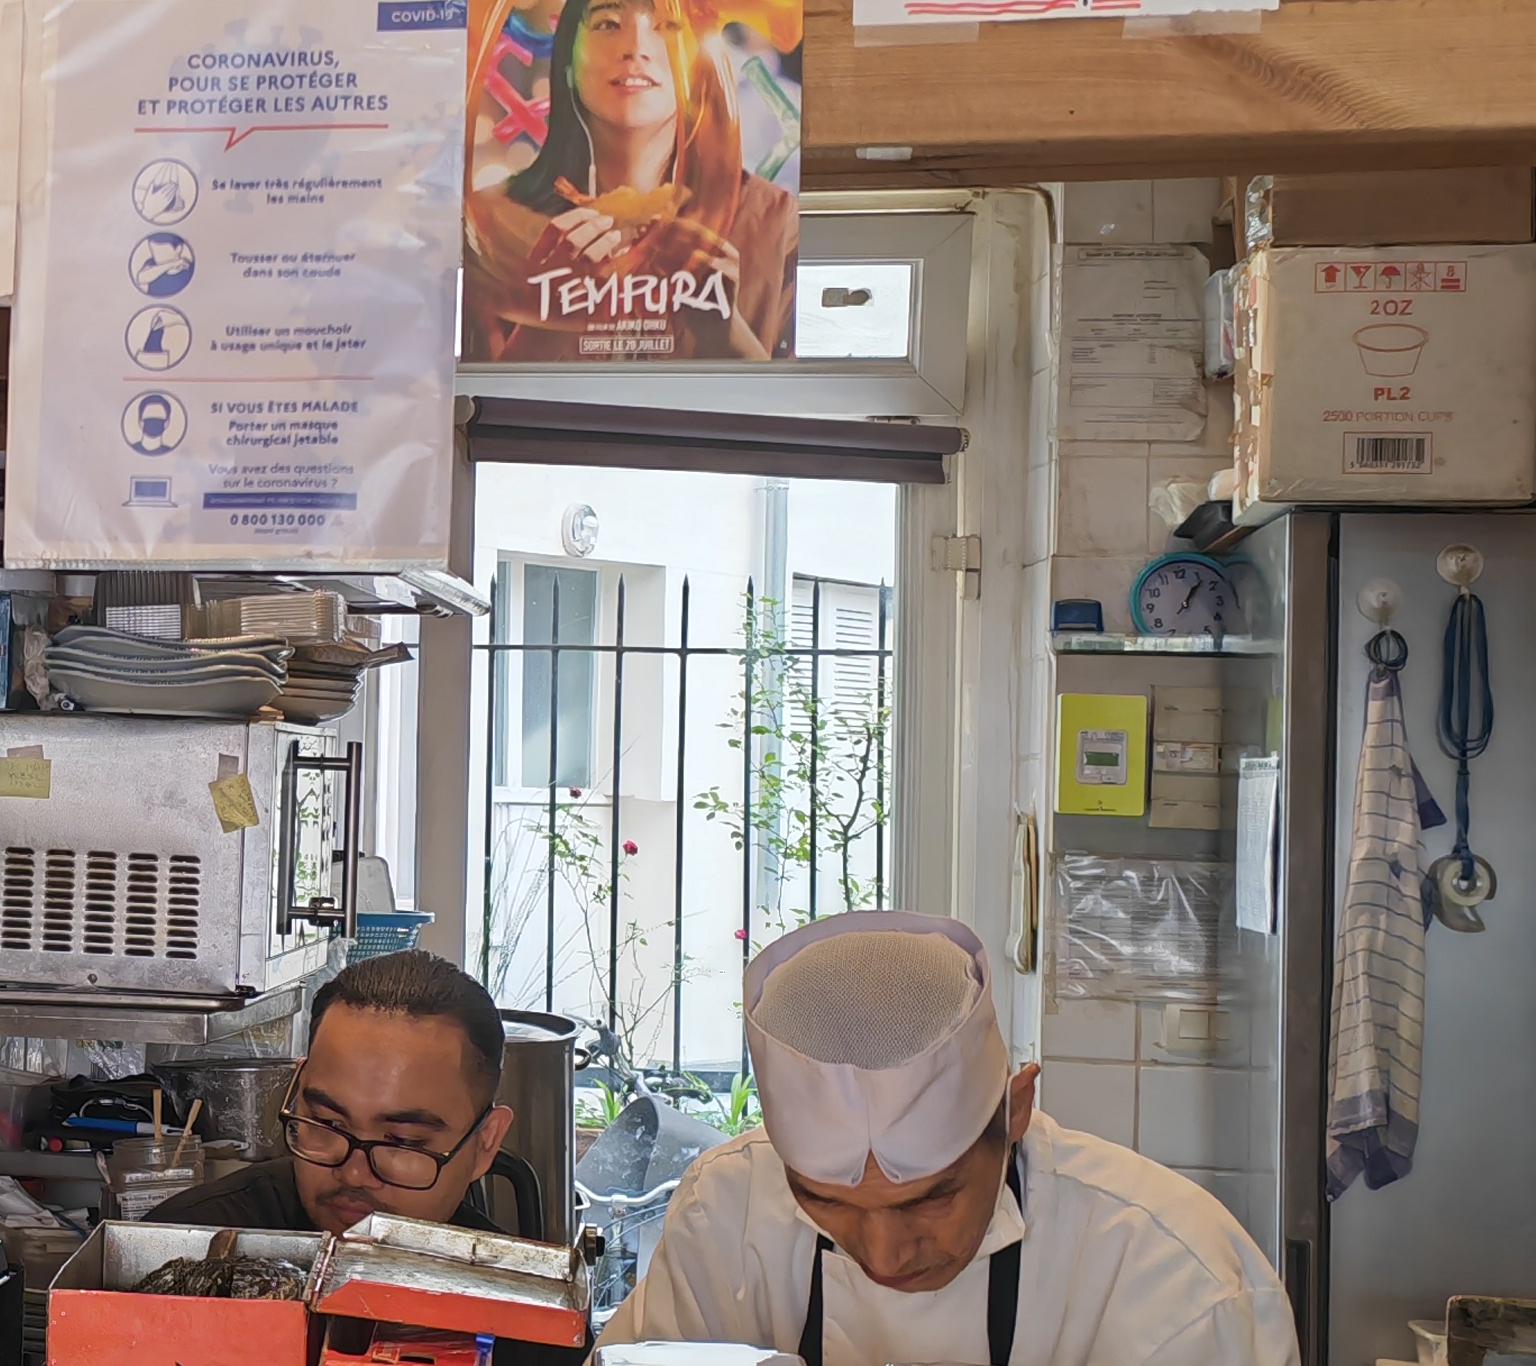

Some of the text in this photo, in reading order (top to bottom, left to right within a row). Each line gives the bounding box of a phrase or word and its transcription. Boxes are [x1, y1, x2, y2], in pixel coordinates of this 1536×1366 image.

[187, 50, 341, 71] CORONAVIRUS,
[168, 70, 358, 93] POUR SE PROTÉGER
[137, 94, 389, 115] ET PROTÉGER LES AUTRES
[527, 267, 732, 322] TEMPURA
[1374, 387, 1411, 401] PL2
[210, 402, 223, 414] SI
[226, 401, 264, 414] VOUS
[302, 401, 359, 413] MALADE
